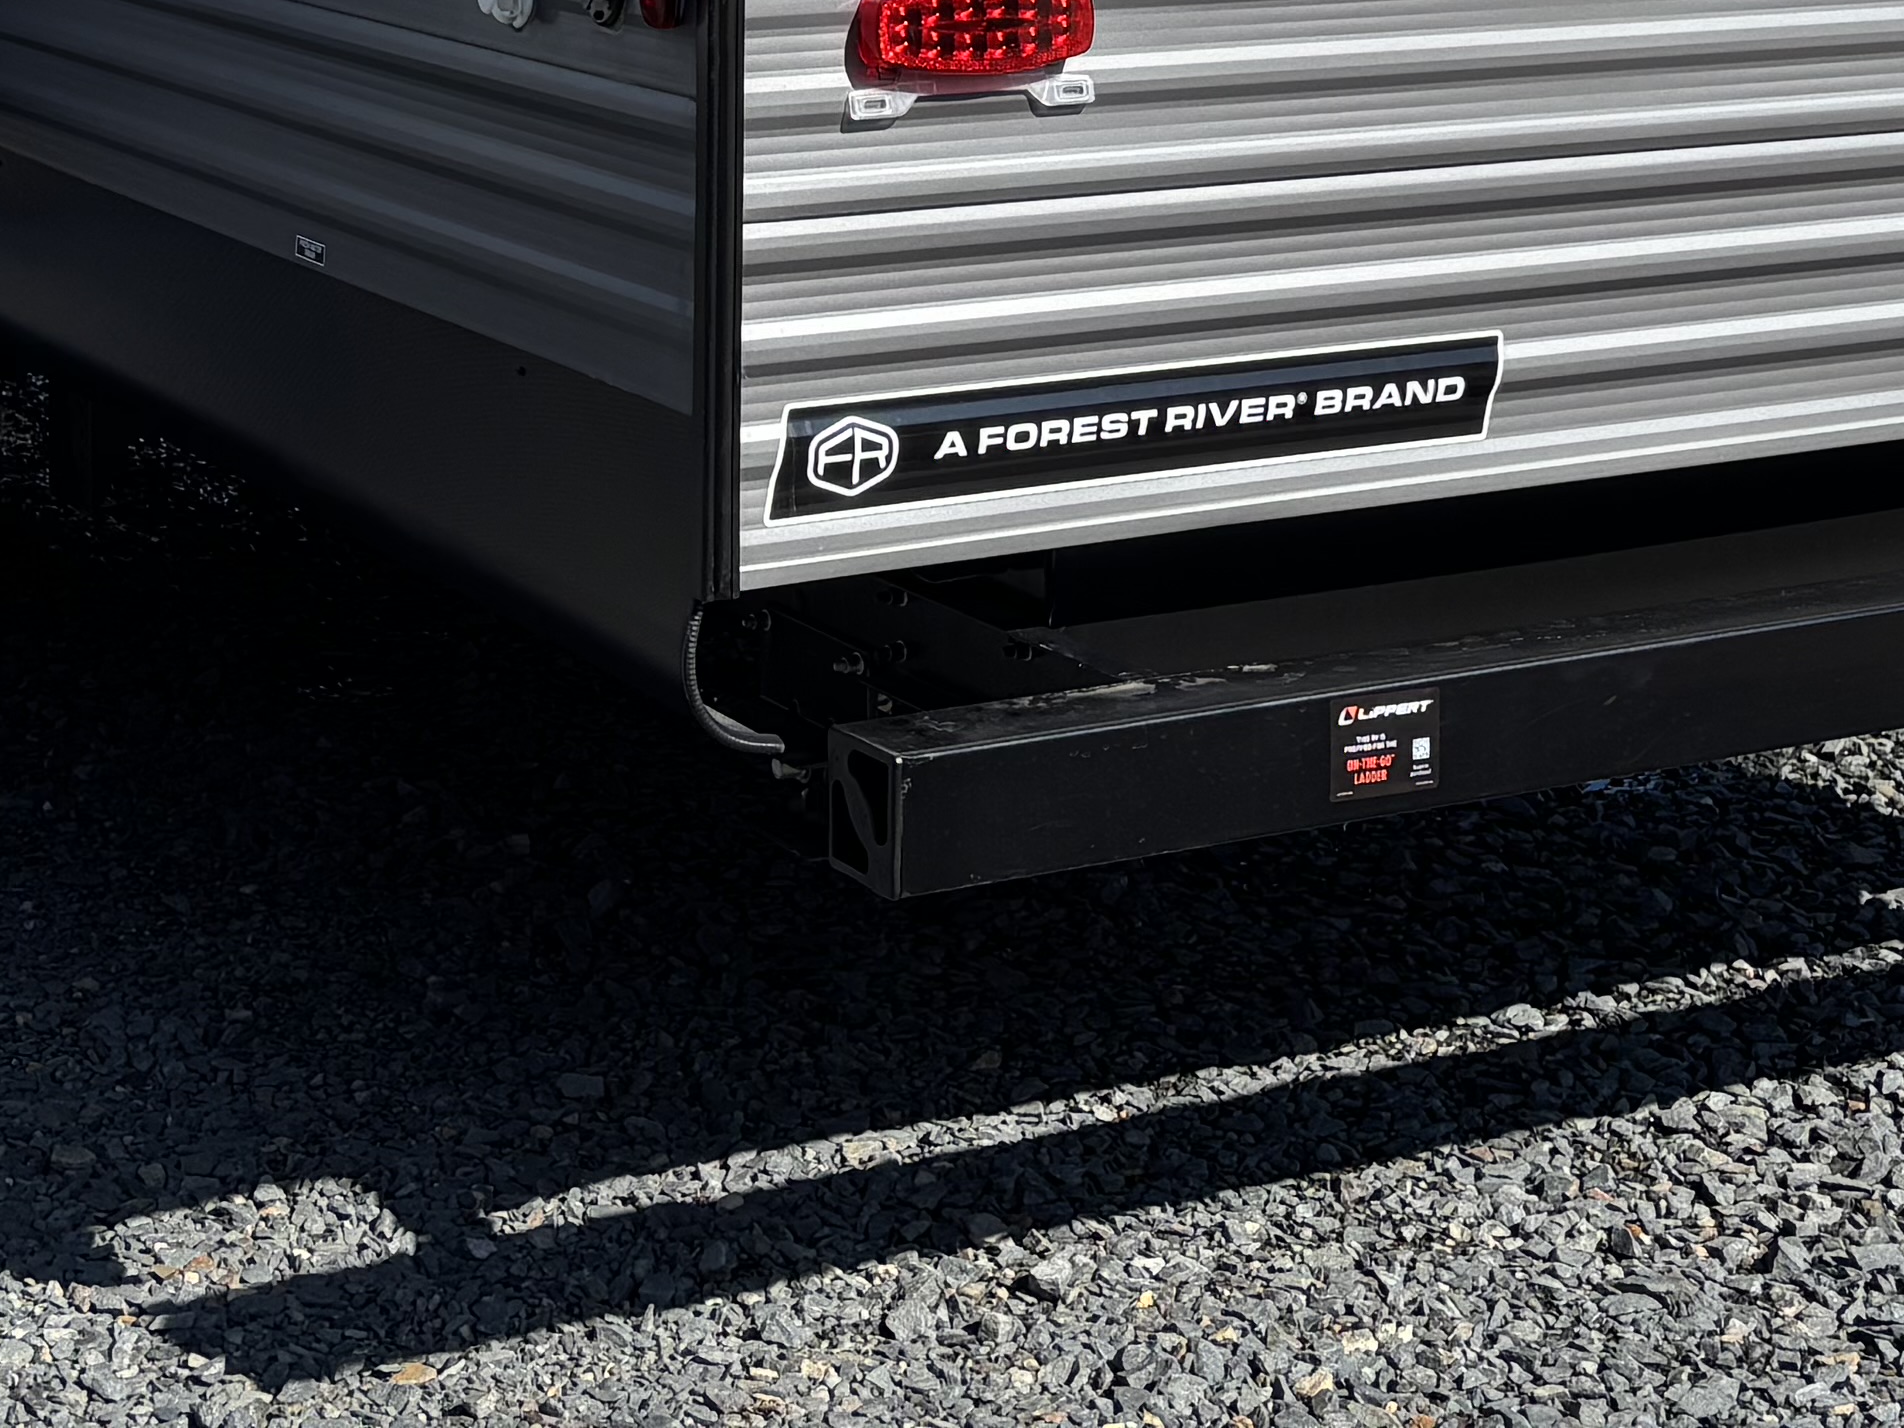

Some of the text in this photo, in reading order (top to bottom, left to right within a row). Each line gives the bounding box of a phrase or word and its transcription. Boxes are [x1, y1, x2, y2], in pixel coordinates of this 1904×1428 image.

[933, 430, 968, 460] A
[977, 408, 1159, 455] FOREST
[1313, 376, 1466, 416] BRAND
[1354, 769, 1387, 785] LADDER
